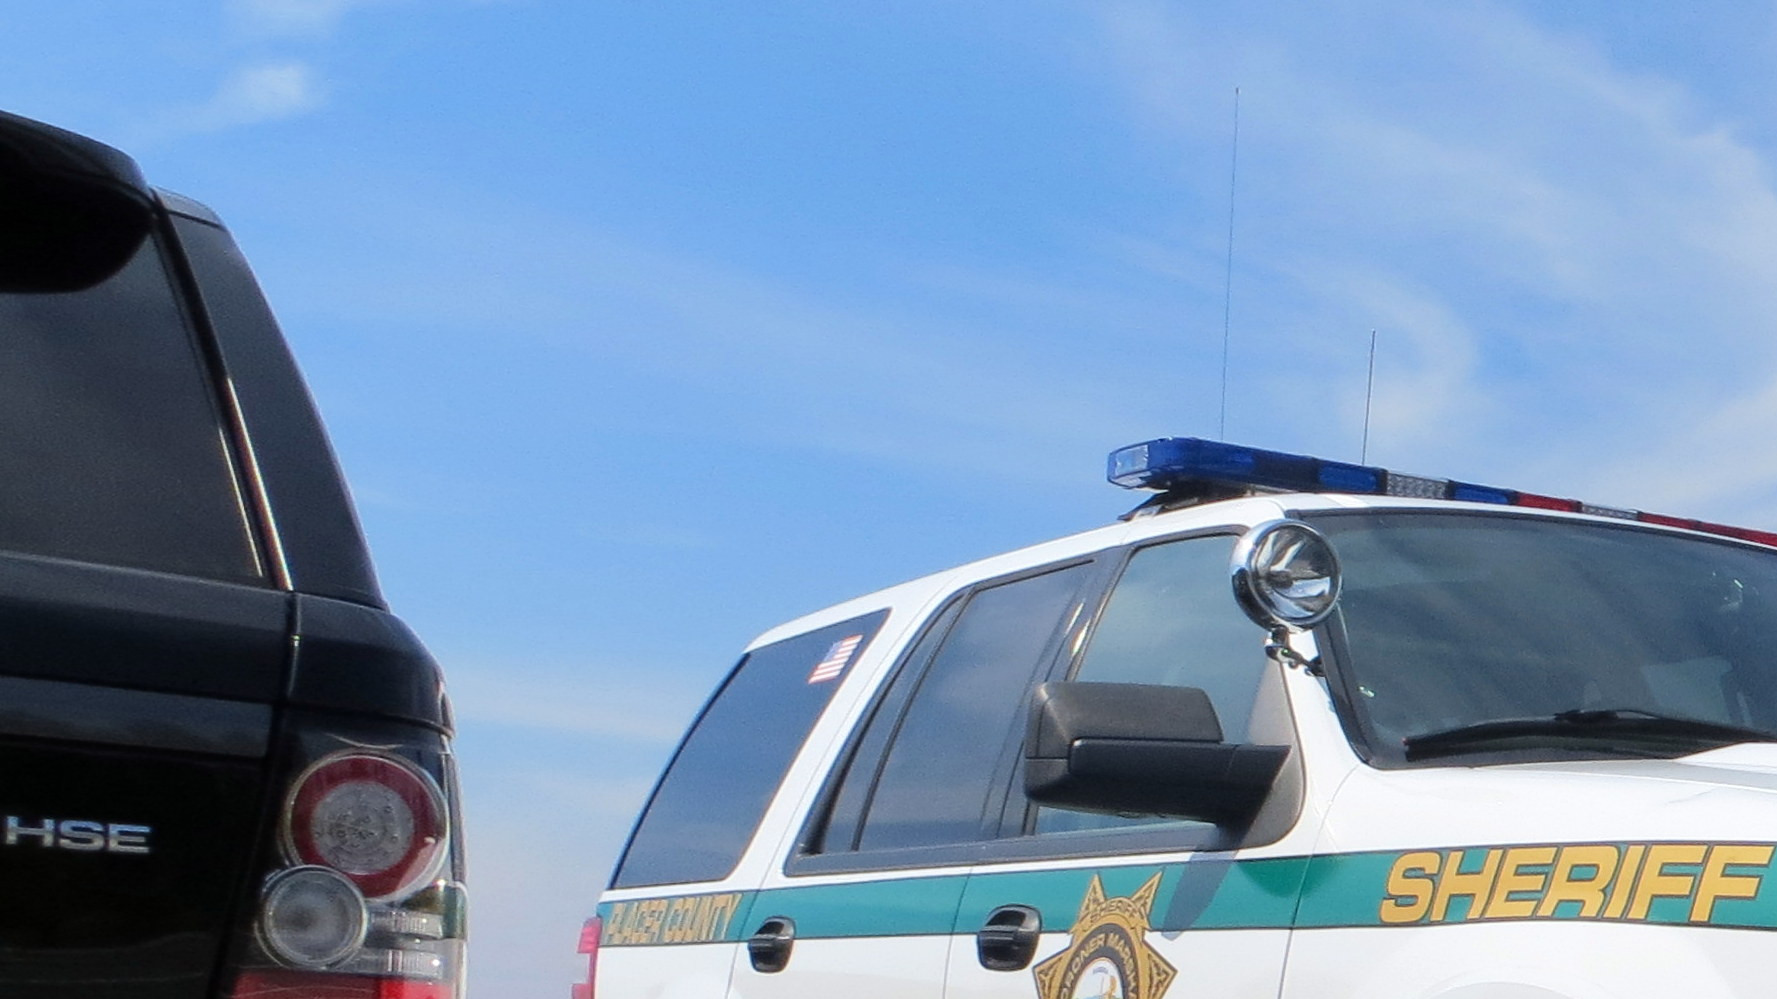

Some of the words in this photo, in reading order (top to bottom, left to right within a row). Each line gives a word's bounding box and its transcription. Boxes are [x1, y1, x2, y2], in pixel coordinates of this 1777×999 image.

[3, 816, 151, 853] HSE
[1379, 844, 1777, 923] SHERIFF
[606, 899, 670, 945] PLACER
[664, 893, 743, 943] COUNTY
[1090, 900, 1140, 923] SHERIFF
